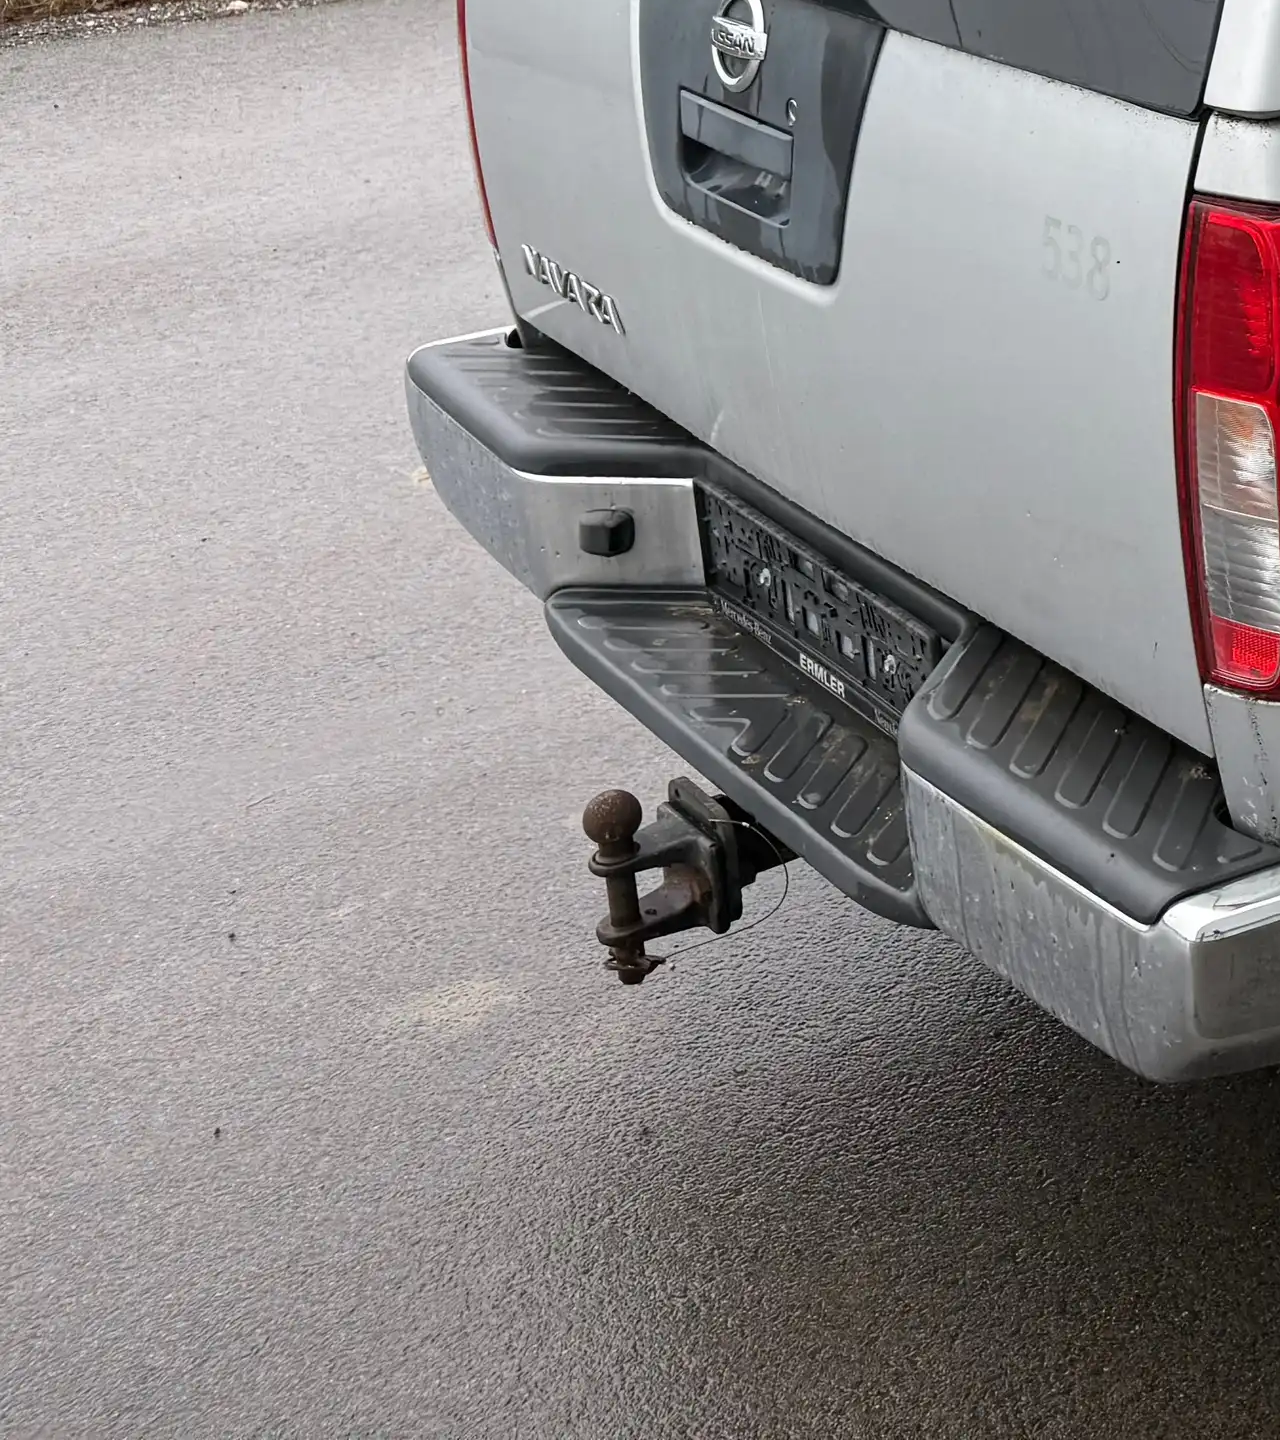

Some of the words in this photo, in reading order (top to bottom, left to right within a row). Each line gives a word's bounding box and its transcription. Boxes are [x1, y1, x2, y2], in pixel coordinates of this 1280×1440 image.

[521, 243, 626, 336] NAVARA
[1041, 215, 1111, 301] 538
[799, 652, 845, 698] ERMLER
